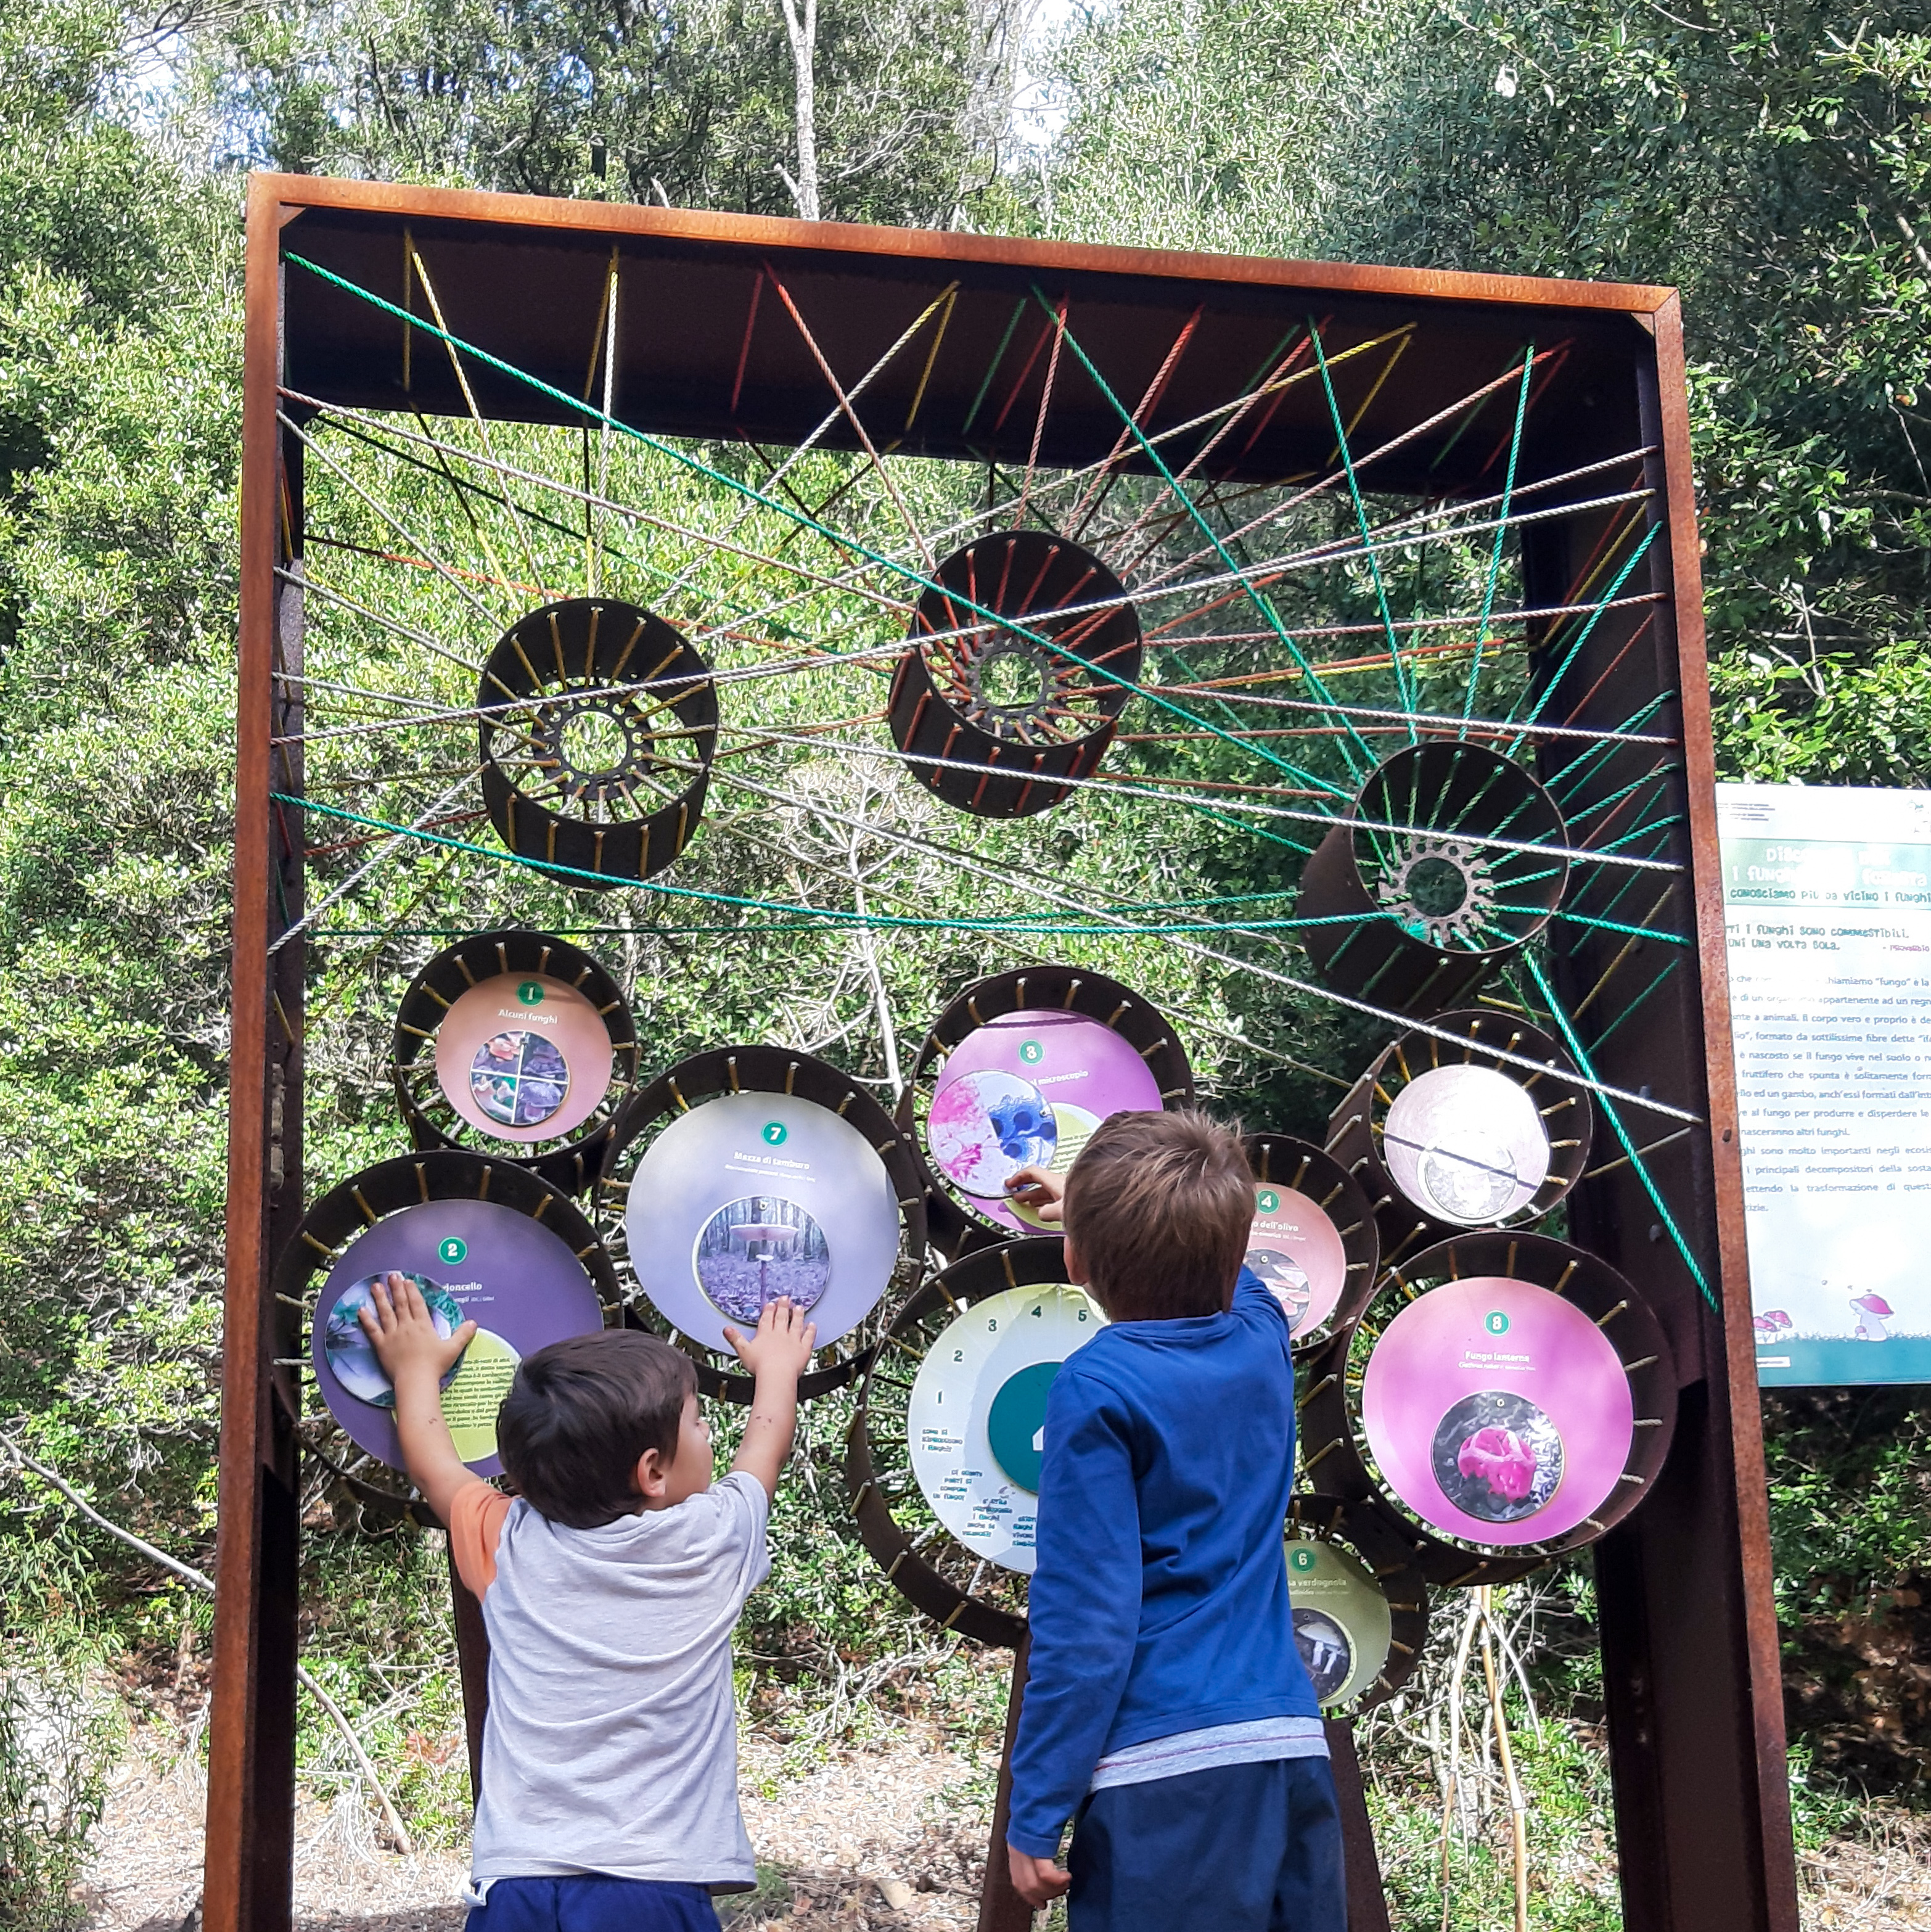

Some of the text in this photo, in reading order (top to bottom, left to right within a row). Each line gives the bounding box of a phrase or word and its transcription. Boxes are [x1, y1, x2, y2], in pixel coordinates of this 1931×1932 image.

[528, 986, 535, 1000] 1
[1882, 997, 1893, 1005] ad
[1811, 1016, 1838, 1024] corpo
[1873, 1016, 1908, 1025] proprio
[1756, 1031, 1793, 1040] formato
[1796, 1032, 1808, 1041] da
[1866, 1034, 1887, 1042] fibre
[1026, 1045, 1038, 1059] 3
[1815, 1051, 1842, 1062] fungo
[1845, 1053, 1865, 1061] vive
[1868, 1053, 1883, 1061] nel
[1787, 1071, 1804, 1079] che
[1808, 1071, 1840, 1080] spunta
[1753, 1089, 1765, 1098] ed
[1862, 1090, 1896, 1099] formati
[1751, 1108, 1760, 1116] al
[1763, 1108, 1791, 1119] fungo
[1794, 1111, 1810, 1119] per
[1813, 1109, 1855, 1119] produrre
[1867, 1109, 1917, 1119] disperdere
[769, 1127, 782, 1141] 7
[1796, 1127, 1814, 1136] altri
[1788, 1147, 1816, 1155] molto
[1877, 1146, 1900, 1156] negli
[763, 1156, 772, 1164] di
[1755, 1165, 1800, 1175] principali
[1805, 1165, 1874, 1175] decompositori
[1879, 1164, 1902, 1172] della
[1745, 1185, 1784, 1193] ettendo
[1806, 1183, 1879, 1192] trasformazione
[1261, 1194, 1272, 1207] 4
[447, 1243, 458, 1257] 2
[442, 1281, 483, 1293] doncello
[1031, 1305, 1042, 1318] 4
[1078, 1309, 1088, 1322] 5
[988, 1318, 998, 1332] 3
[1492, 1315, 1503, 1330] 8
[953, 1349, 963, 1362] 2
[1465, 1350, 1493, 1362] Fungo
[937, 1390, 943, 1404] 1
[1298, 1552, 1308, 1566] 6
